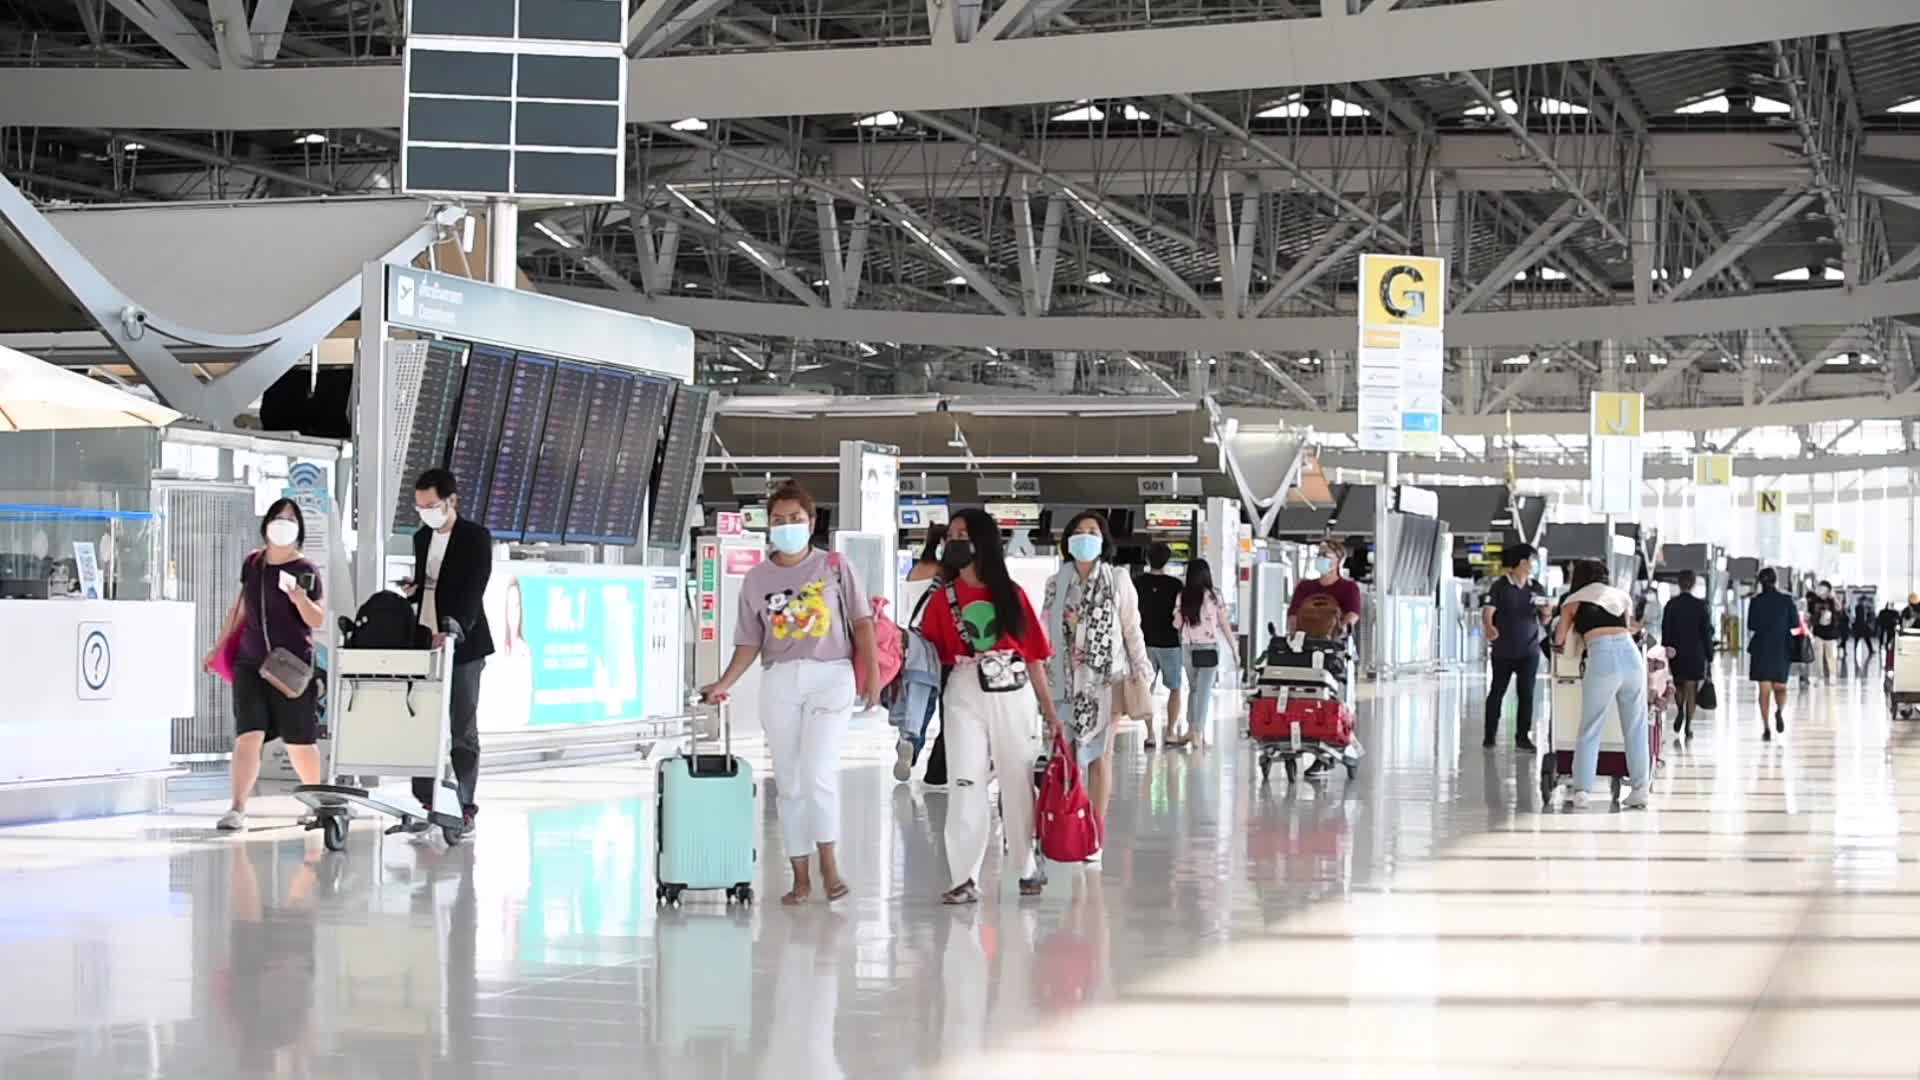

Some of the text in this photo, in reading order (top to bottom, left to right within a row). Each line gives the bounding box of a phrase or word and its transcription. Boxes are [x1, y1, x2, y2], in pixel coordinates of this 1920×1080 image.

[1380, 265, 1425, 319] G
[1607, 399, 1630, 434] J
[1143, 480, 1164, 491] G01
[1762, 492, 1776, 512] N
